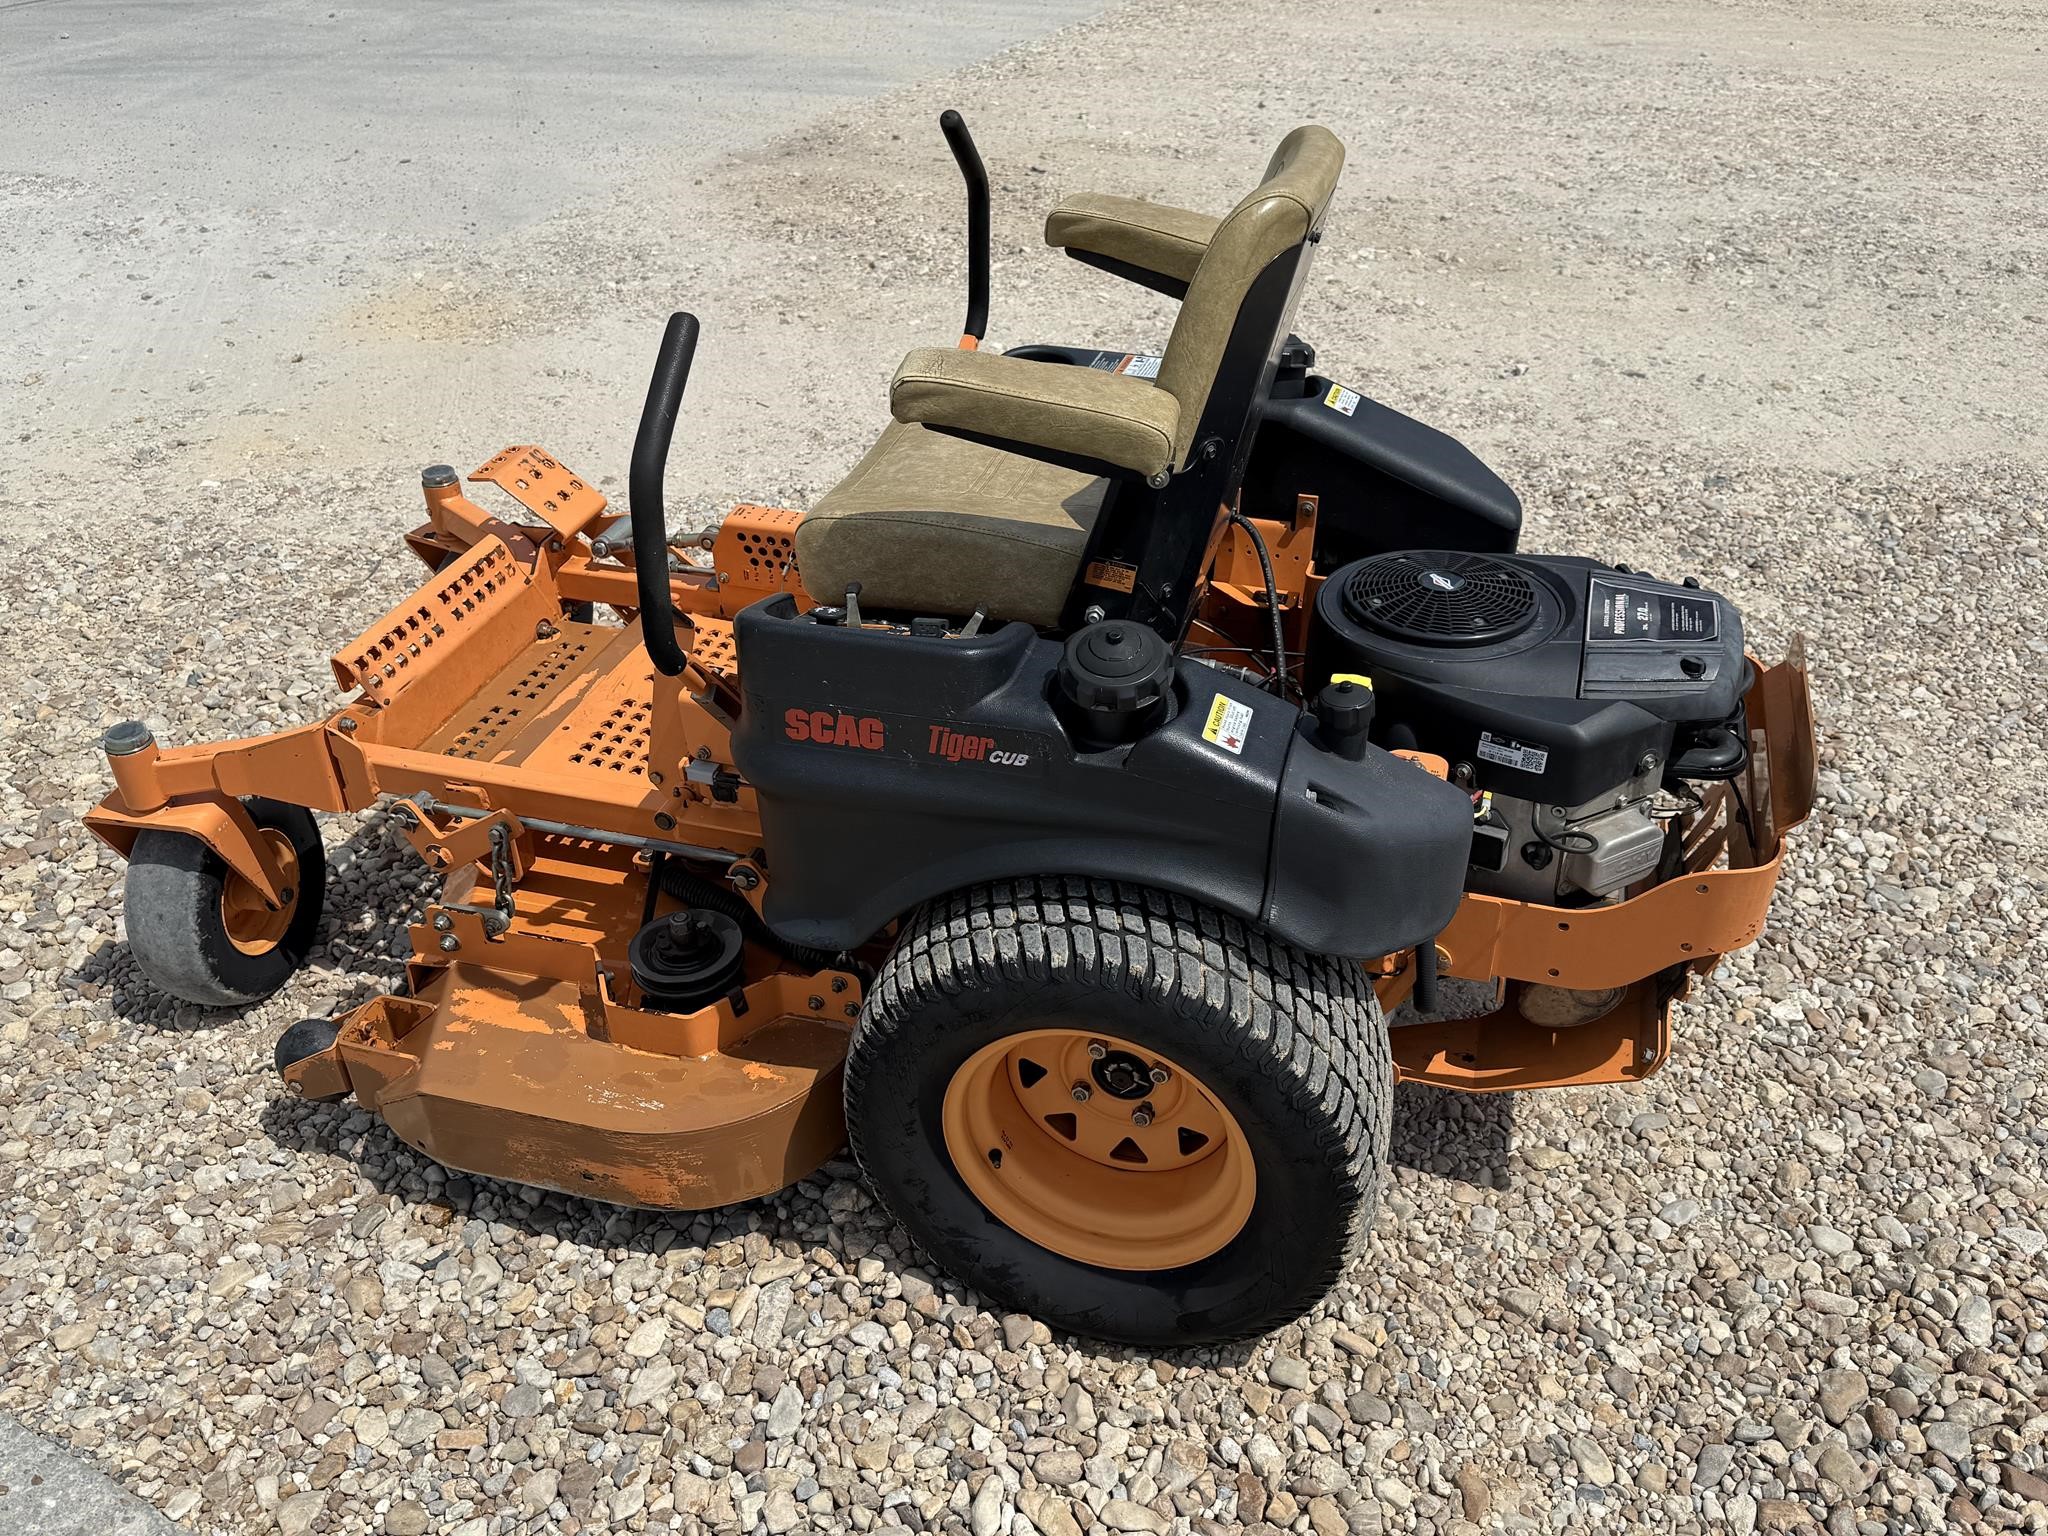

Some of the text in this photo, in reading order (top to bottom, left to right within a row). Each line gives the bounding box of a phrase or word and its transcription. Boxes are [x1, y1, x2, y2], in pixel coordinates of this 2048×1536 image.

[1613, 592, 1626, 635] PROFESSIONAL
[1213, 701, 1226, 727] CAUTION
[784, 708, 1029, 767] SCAG Tiger CUB
